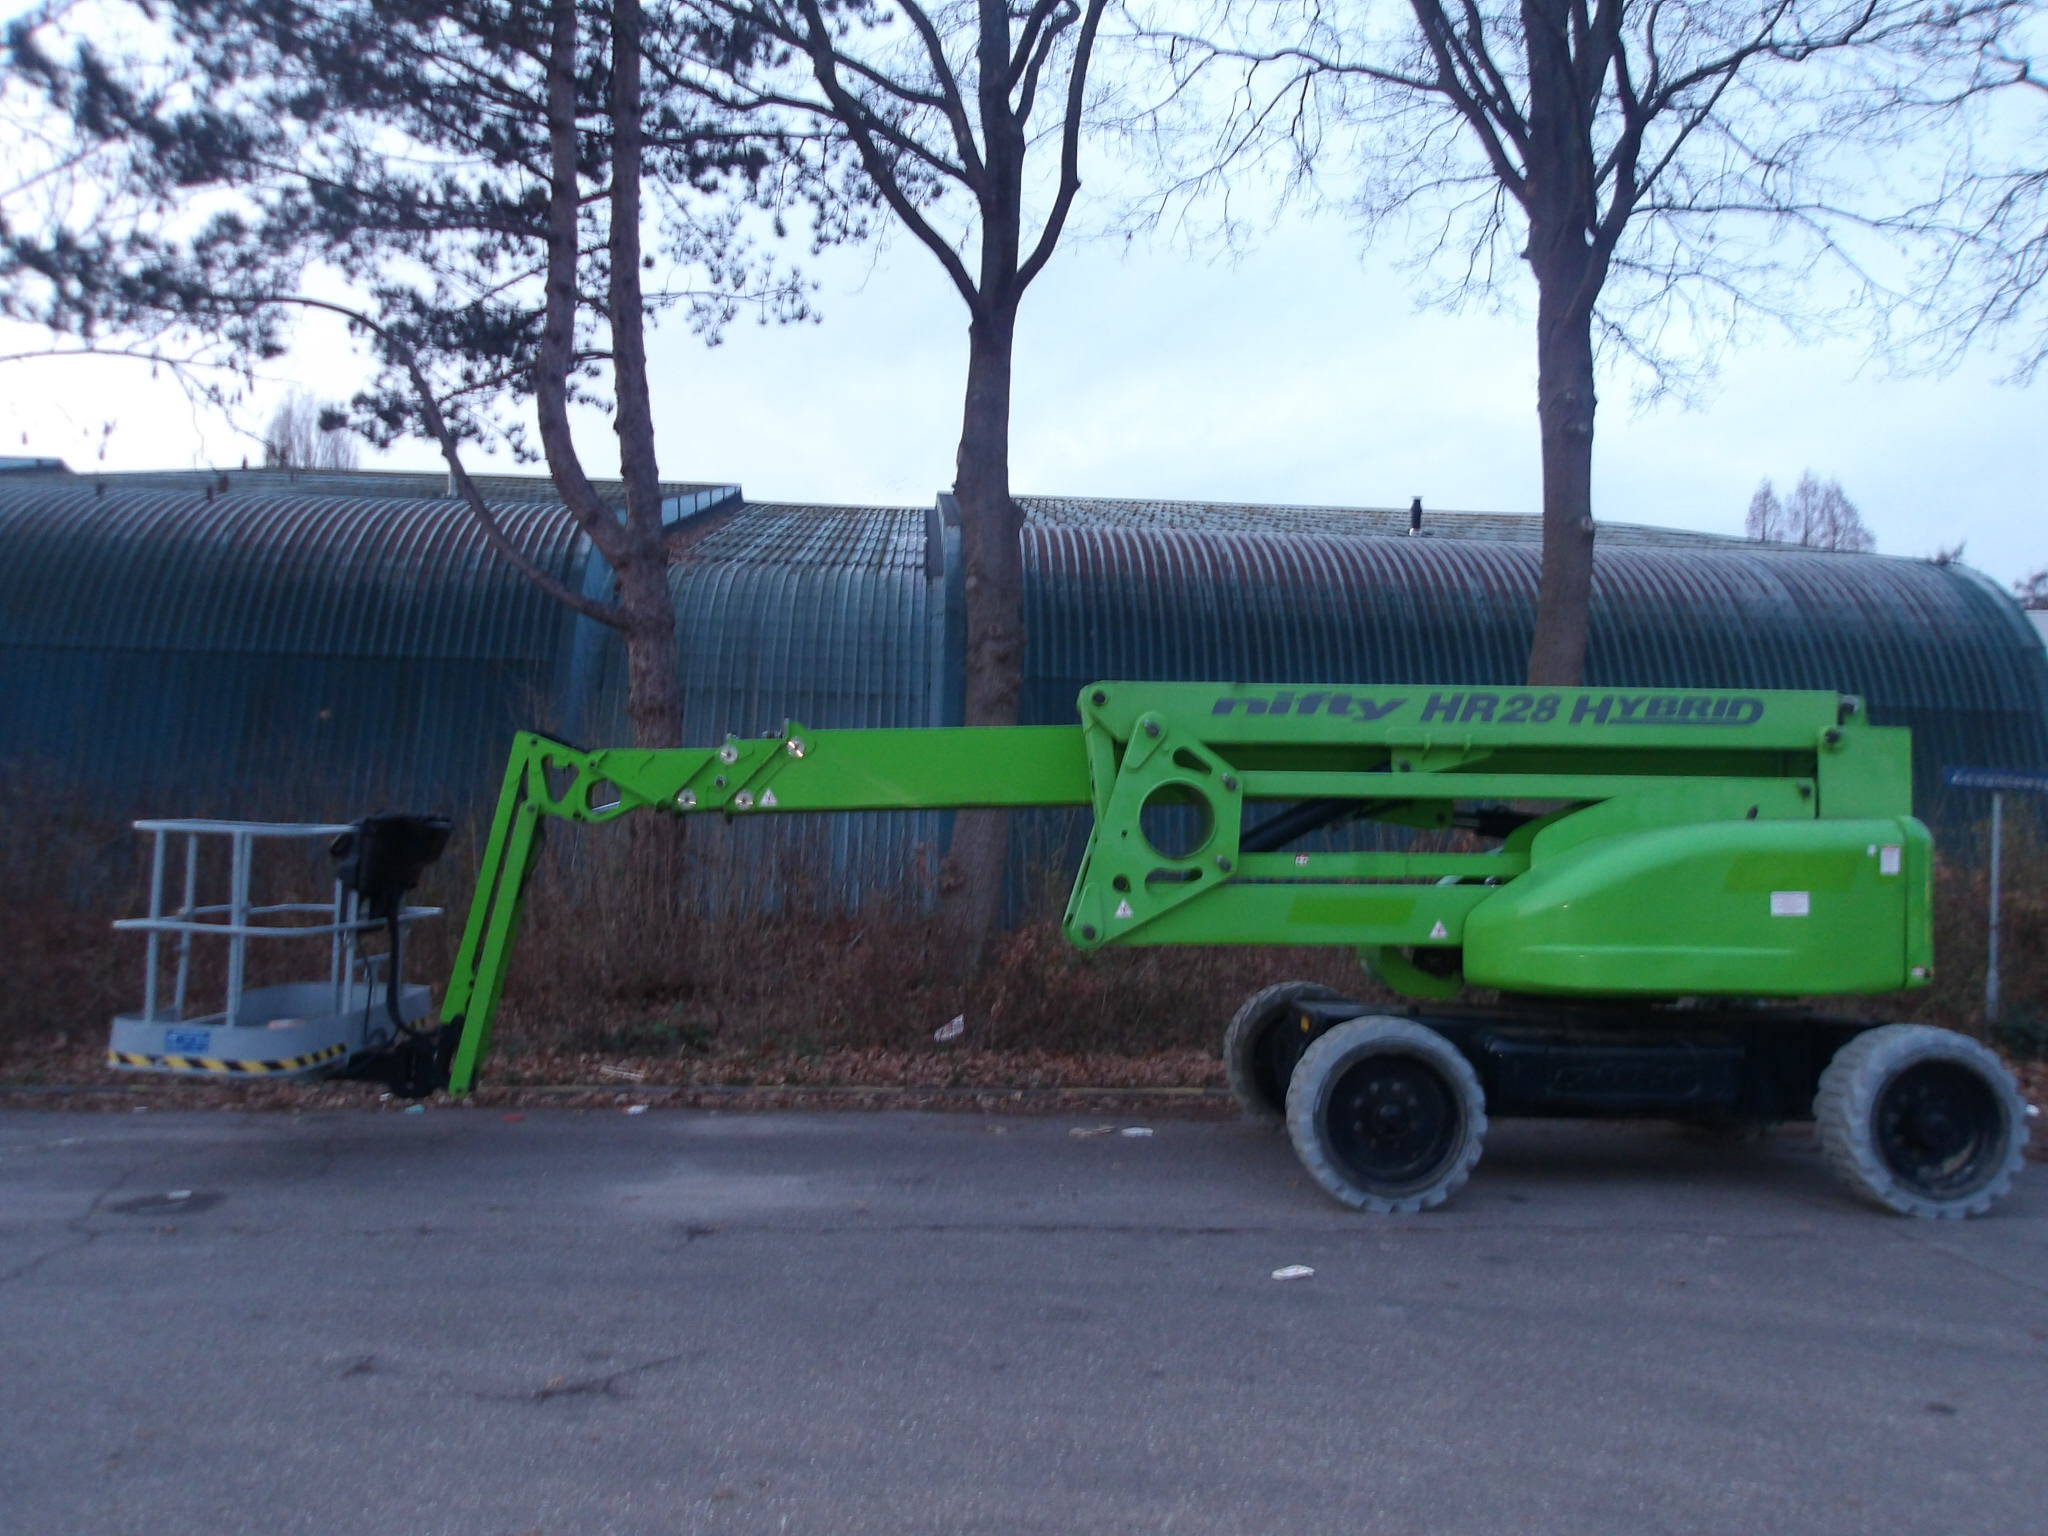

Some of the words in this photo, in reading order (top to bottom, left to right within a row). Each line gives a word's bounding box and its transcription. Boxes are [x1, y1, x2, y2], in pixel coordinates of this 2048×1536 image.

[1211, 691, 1408, 722] nifty
[1420, 693, 1561, 723] HR28
[1569, 694, 1765, 726] HYBRID
